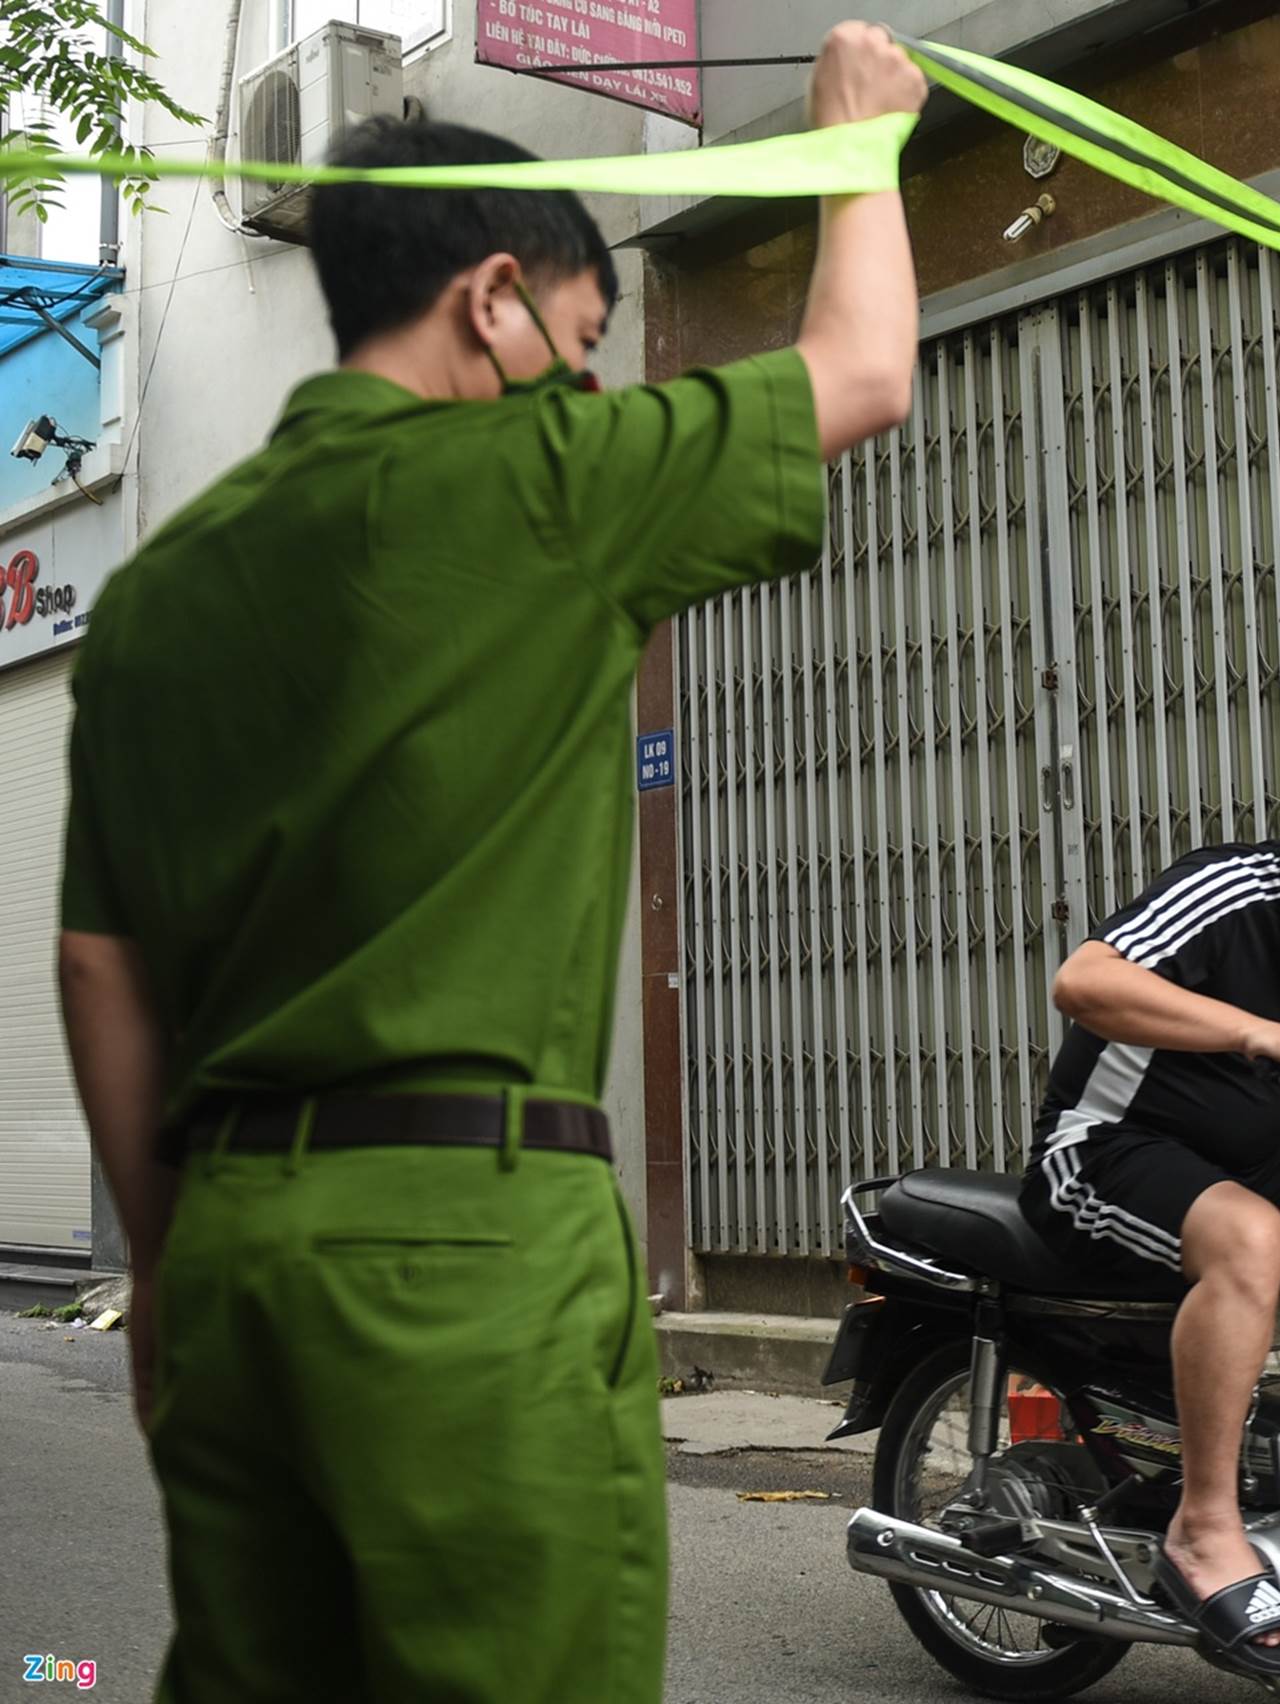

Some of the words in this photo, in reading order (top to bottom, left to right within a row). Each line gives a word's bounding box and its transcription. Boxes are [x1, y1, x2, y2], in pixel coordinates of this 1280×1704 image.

[589, 1, 615, 23] SANG
[546, 12, 568, 32] TAY
[571, 19, 590, 39] LÁI
[644, 743, 654, 758] LK
